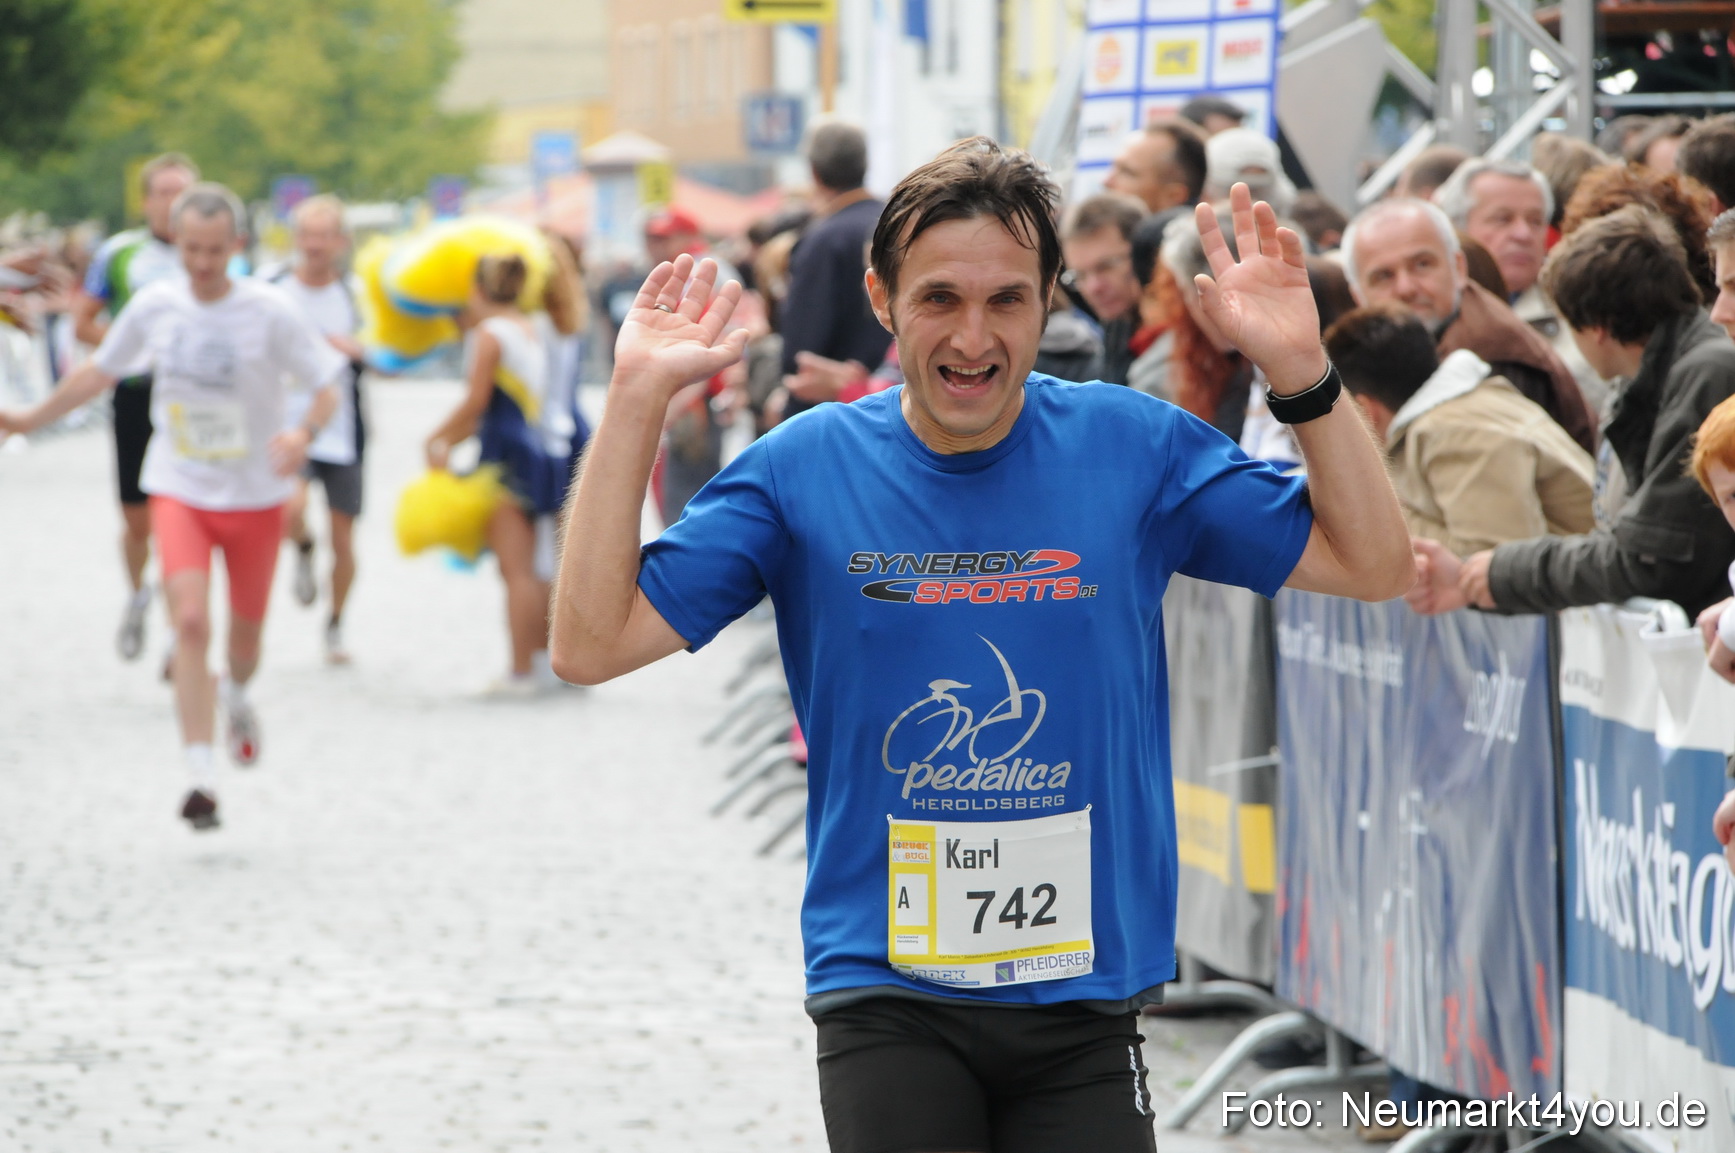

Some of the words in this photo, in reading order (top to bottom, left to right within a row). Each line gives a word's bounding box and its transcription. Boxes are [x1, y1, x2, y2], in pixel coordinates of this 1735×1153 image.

[847, 551, 1038, 575] SYNERGY
[901, 758, 1071, 799] pedalica
[912, 794, 1065, 811] HEROLDSBERG
[946, 838, 999, 869] Karl
[897, 886, 910, 909] A
[966, 883, 1057, 934] 742
[1017, 952, 1091, 972] PFLEIDERER
